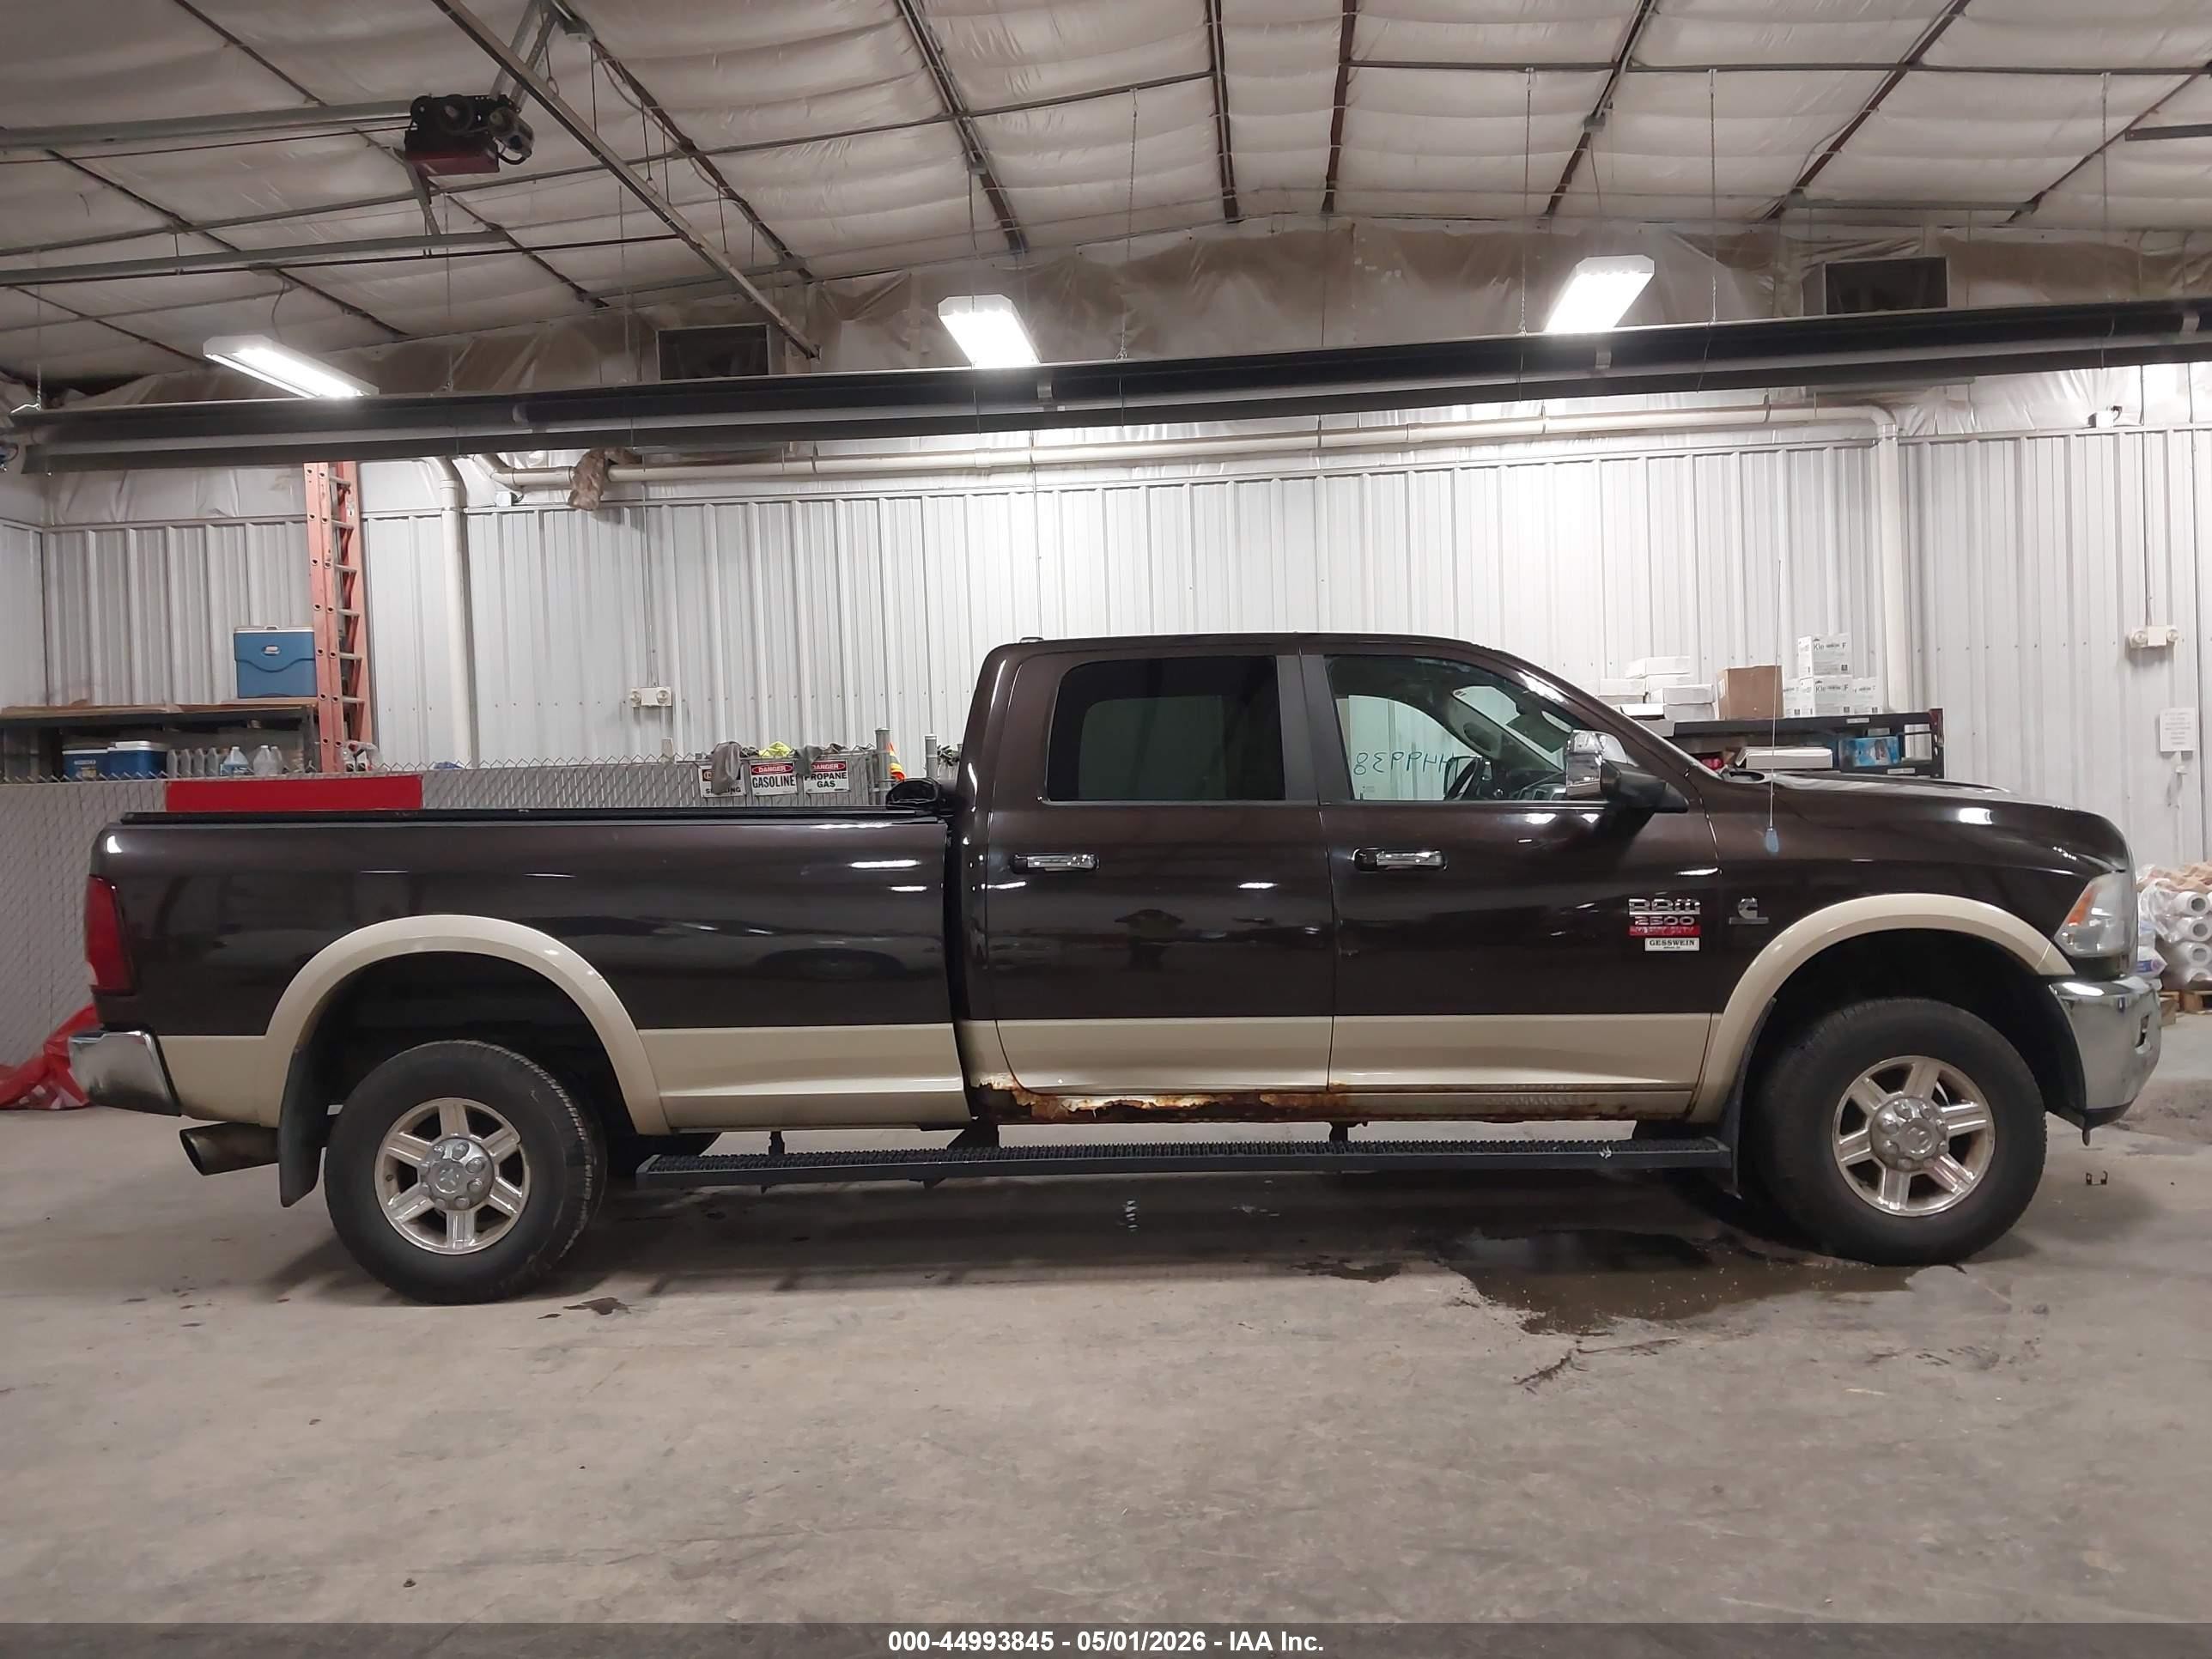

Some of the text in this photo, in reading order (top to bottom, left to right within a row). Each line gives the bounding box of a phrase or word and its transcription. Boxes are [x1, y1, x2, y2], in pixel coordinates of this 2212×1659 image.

[752, 775, 796, 788] GASOLINE
[817, 780, 836, 788] GAS
[1635, 915, 1695, 926] 2500
